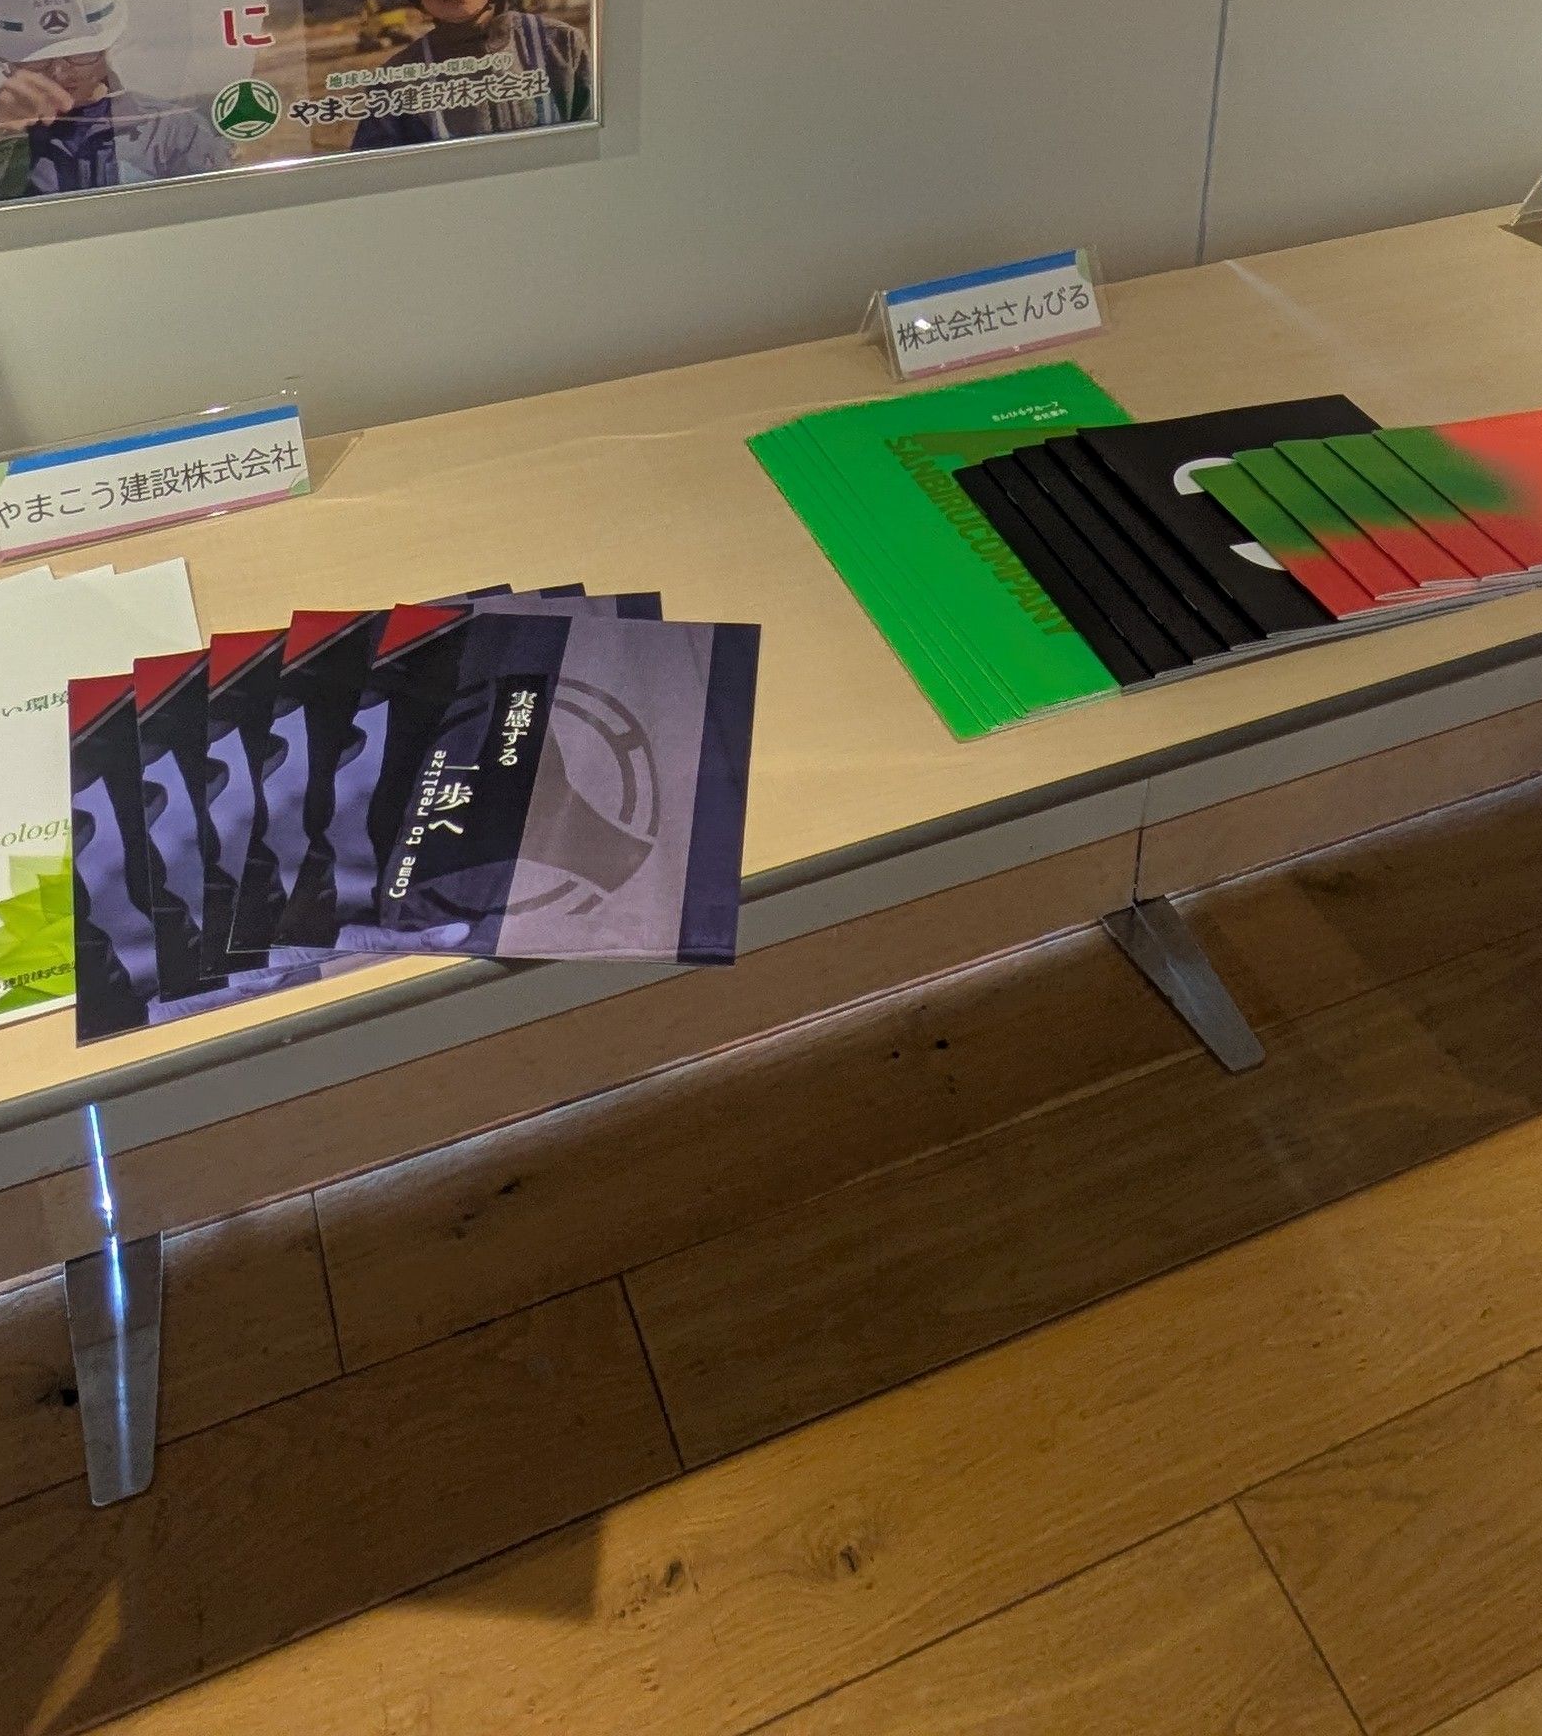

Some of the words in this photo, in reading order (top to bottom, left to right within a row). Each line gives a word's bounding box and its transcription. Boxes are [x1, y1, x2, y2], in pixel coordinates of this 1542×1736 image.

[288, 69, 552, 127] やまこう建設株式会社
[897, 282, 1094, 353] 株式会社さんびる
[498, 690, 538, 766] 実感する
[389, 856, 416, 899] Come
[406, 826, 425, 845] to
[416, 750, 447, 817] realize
[428, 764, 480, 835] 一歩へ
